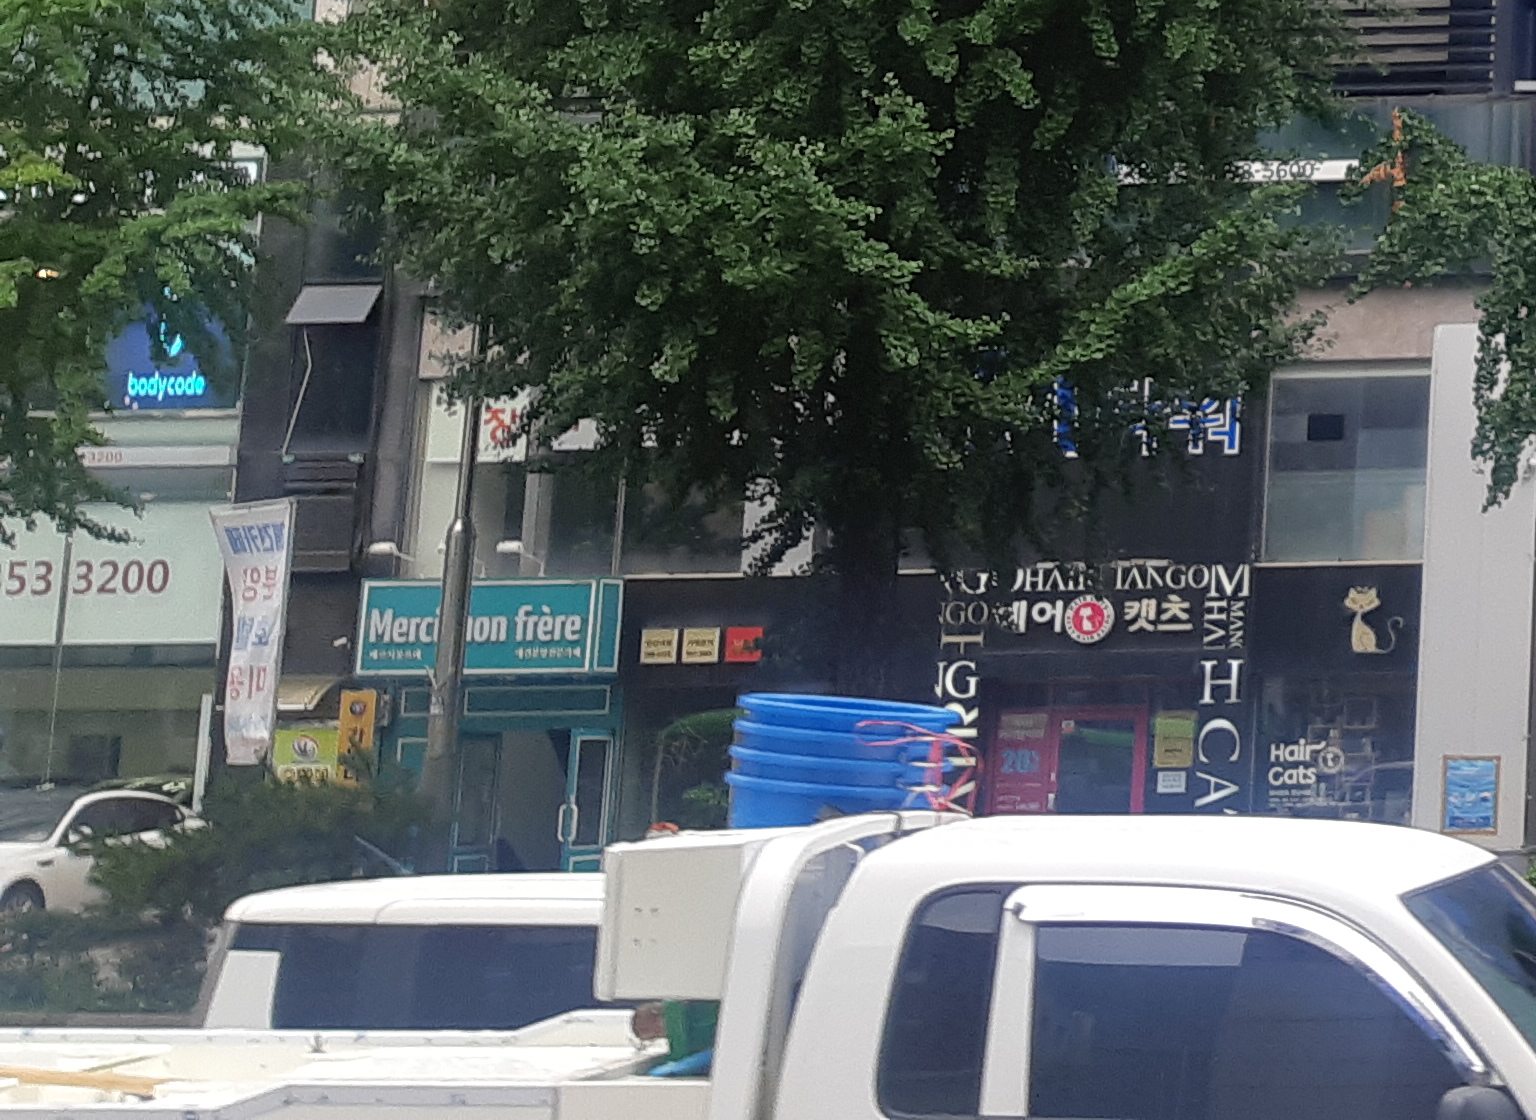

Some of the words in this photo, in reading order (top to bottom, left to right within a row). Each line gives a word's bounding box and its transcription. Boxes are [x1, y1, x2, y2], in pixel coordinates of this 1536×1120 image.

[128, 370, 206, 401] bodycode
[72, 558, 171, 595] 3200
[1270, 737, 1326, 763] Hair
